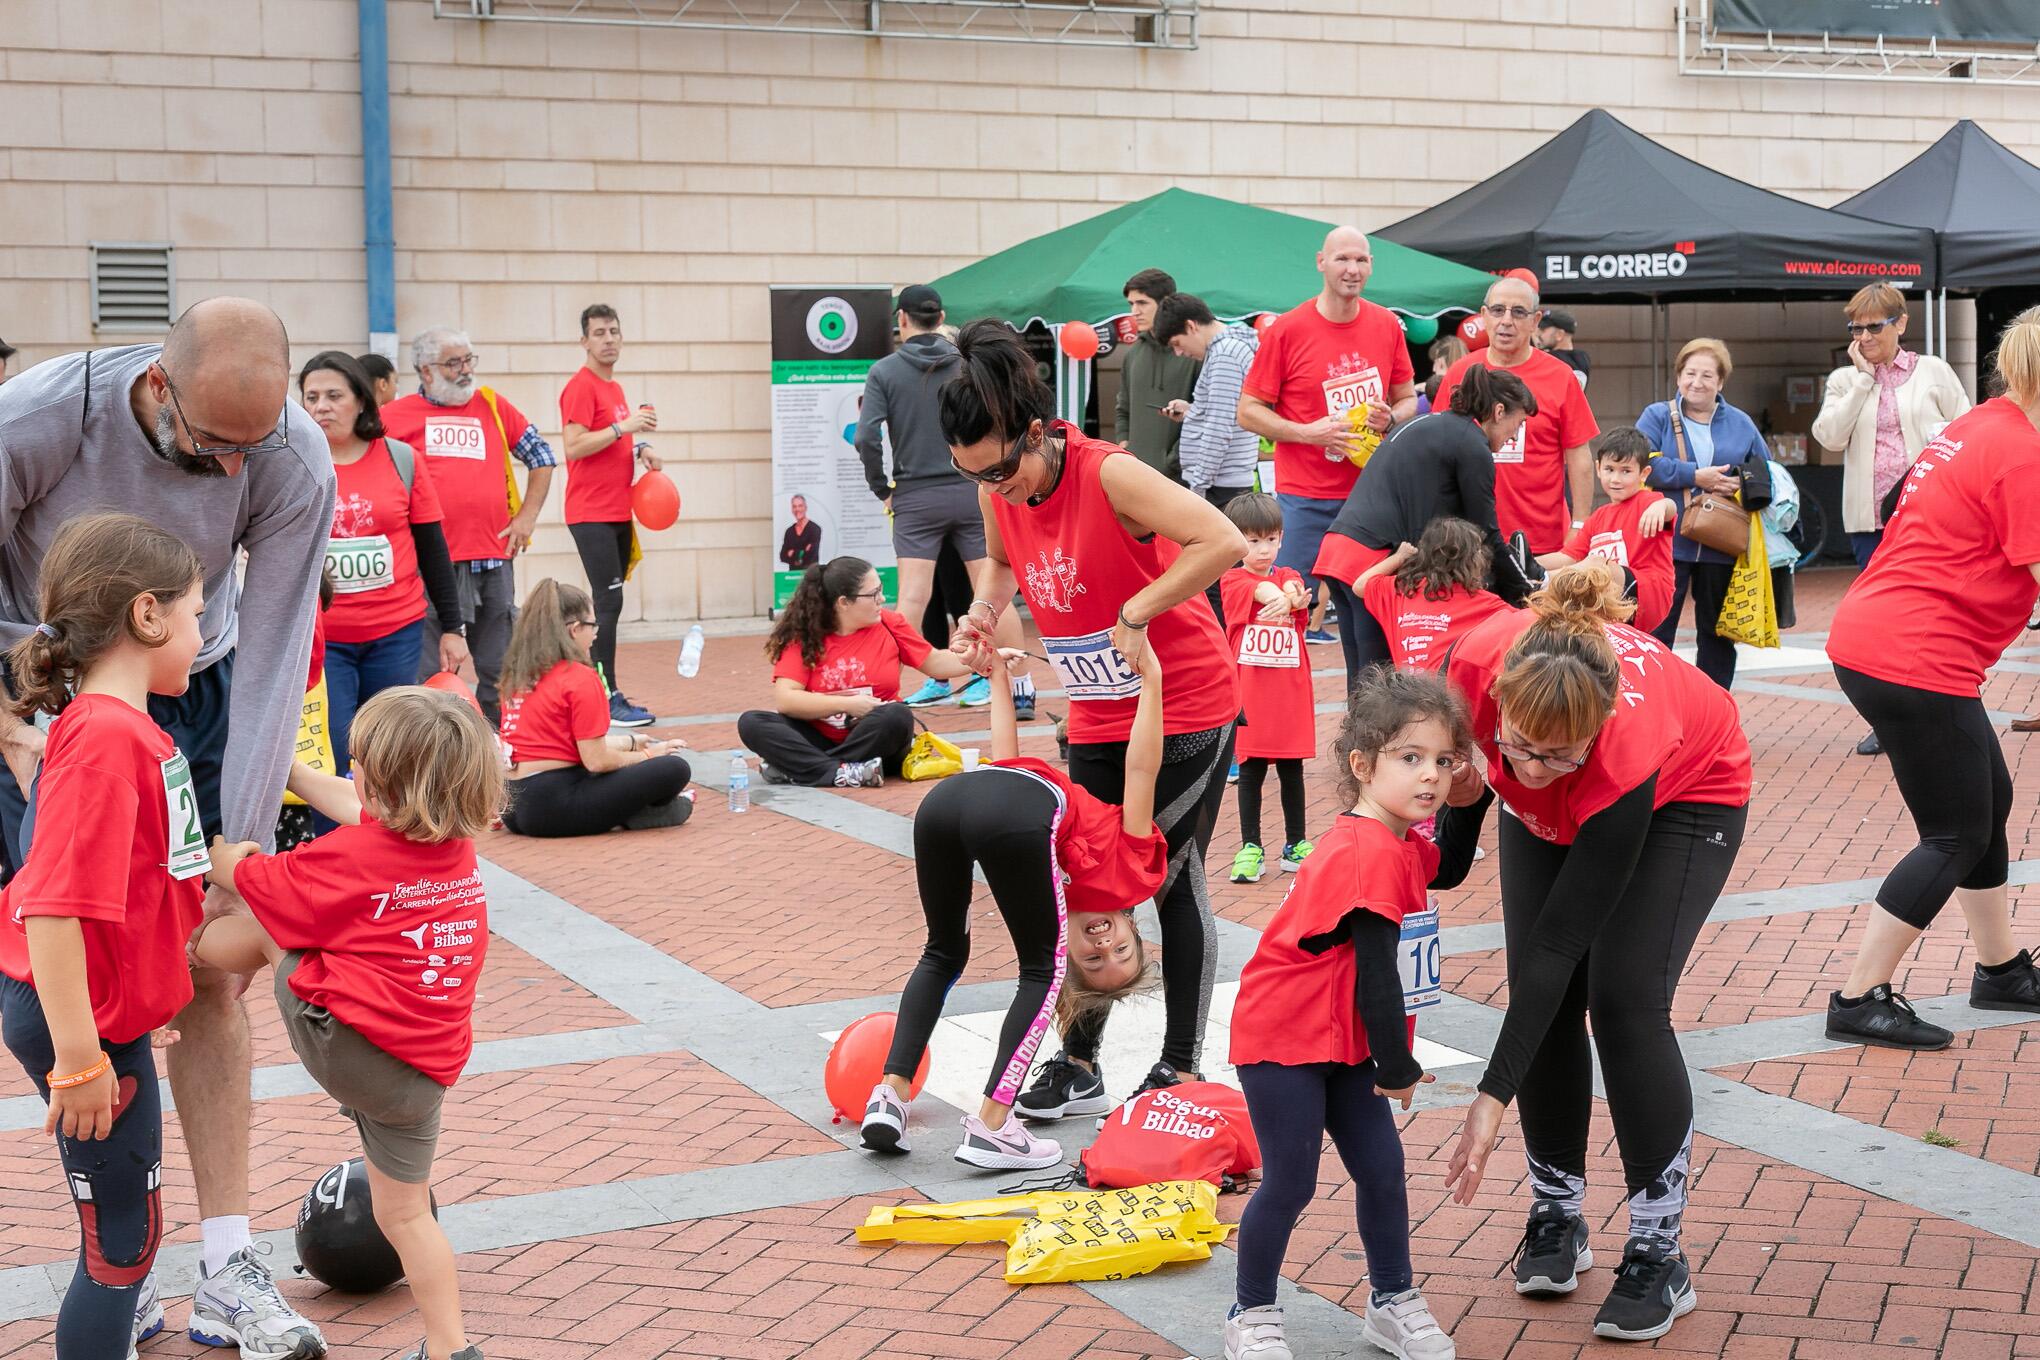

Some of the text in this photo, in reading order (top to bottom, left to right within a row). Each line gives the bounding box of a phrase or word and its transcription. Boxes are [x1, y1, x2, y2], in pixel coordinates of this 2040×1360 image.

[1546, 253, 1687, 279] EL CORREO
[1785, 260, 1921, 275] www.elcorreo.com
[1332, 382, 1376, 411] 3004
[432, 427, 480, 447] 3009
[324, 552, 386, 579] 2006
[1246, 627, 1293, 654] 3004
[1060, 648, 1136, 683] 1015
[180, 787, 202, 845] 2
[432, 919, 477, 935] Seguros
[433, 934, 473, 948] Bilbao
[1141, 1110, 1216, 1139] Bilbao
